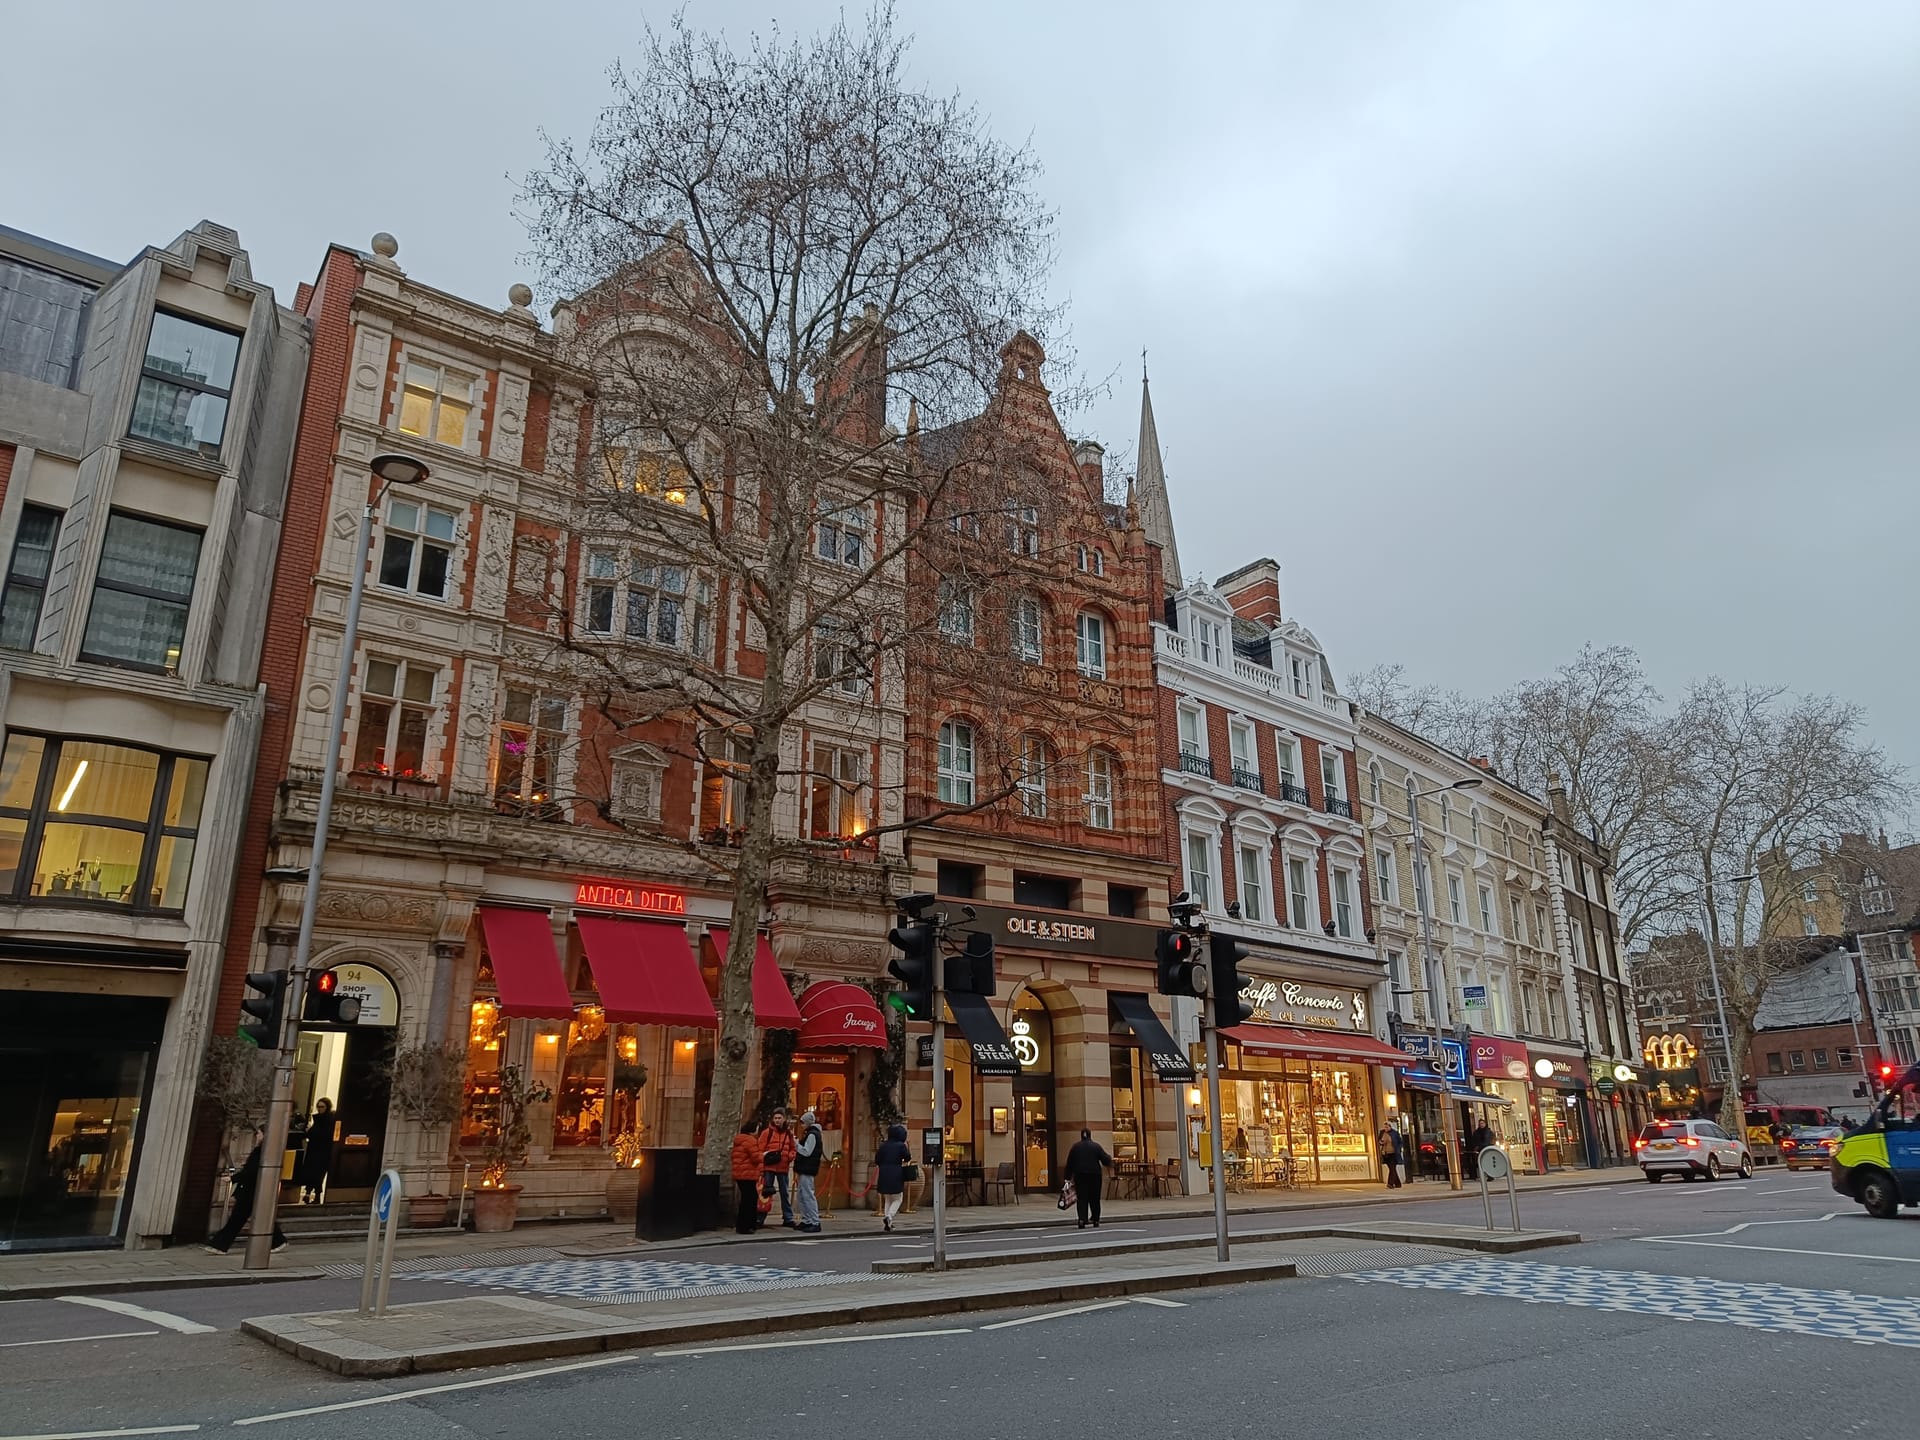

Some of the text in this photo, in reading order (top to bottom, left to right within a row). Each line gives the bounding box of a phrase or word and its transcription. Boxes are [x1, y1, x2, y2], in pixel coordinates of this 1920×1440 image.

[577, 885, 683, 911] ANTICA DITTA
[1007, 917, 1096, 941] OLE & STEEN
[347, 970, 362, 981] 94
[342, 985, 367, 993] SHOP
[1281, 981, 1344, 1010] Concerto
[843, 1012, 877, 1032] Jacuzzi
[973, 1043, 1010, 1052] OLE &
[977, 1052, 1015, 1060] STEEN
[1152, 1053, 1172, 1061] OLE
[1157, 1060, 1189, 1070] STEEN
